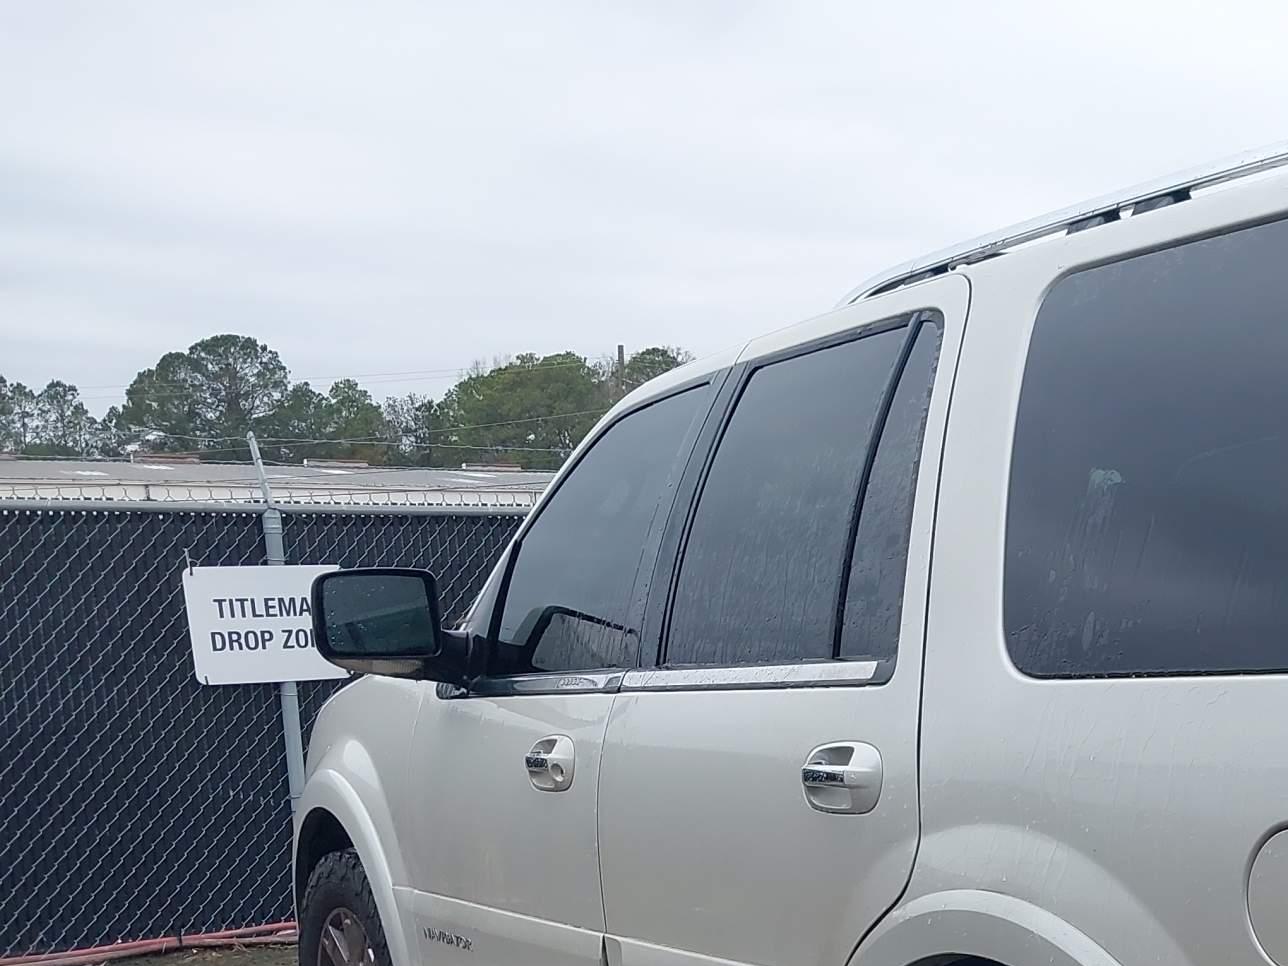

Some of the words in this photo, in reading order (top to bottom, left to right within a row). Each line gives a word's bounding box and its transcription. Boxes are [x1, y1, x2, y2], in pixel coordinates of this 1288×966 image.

[212, 596, 312, 619] TITLEMA
[210, 629, 274, 651] DROP
[281, 628, 316, 649] ZO
